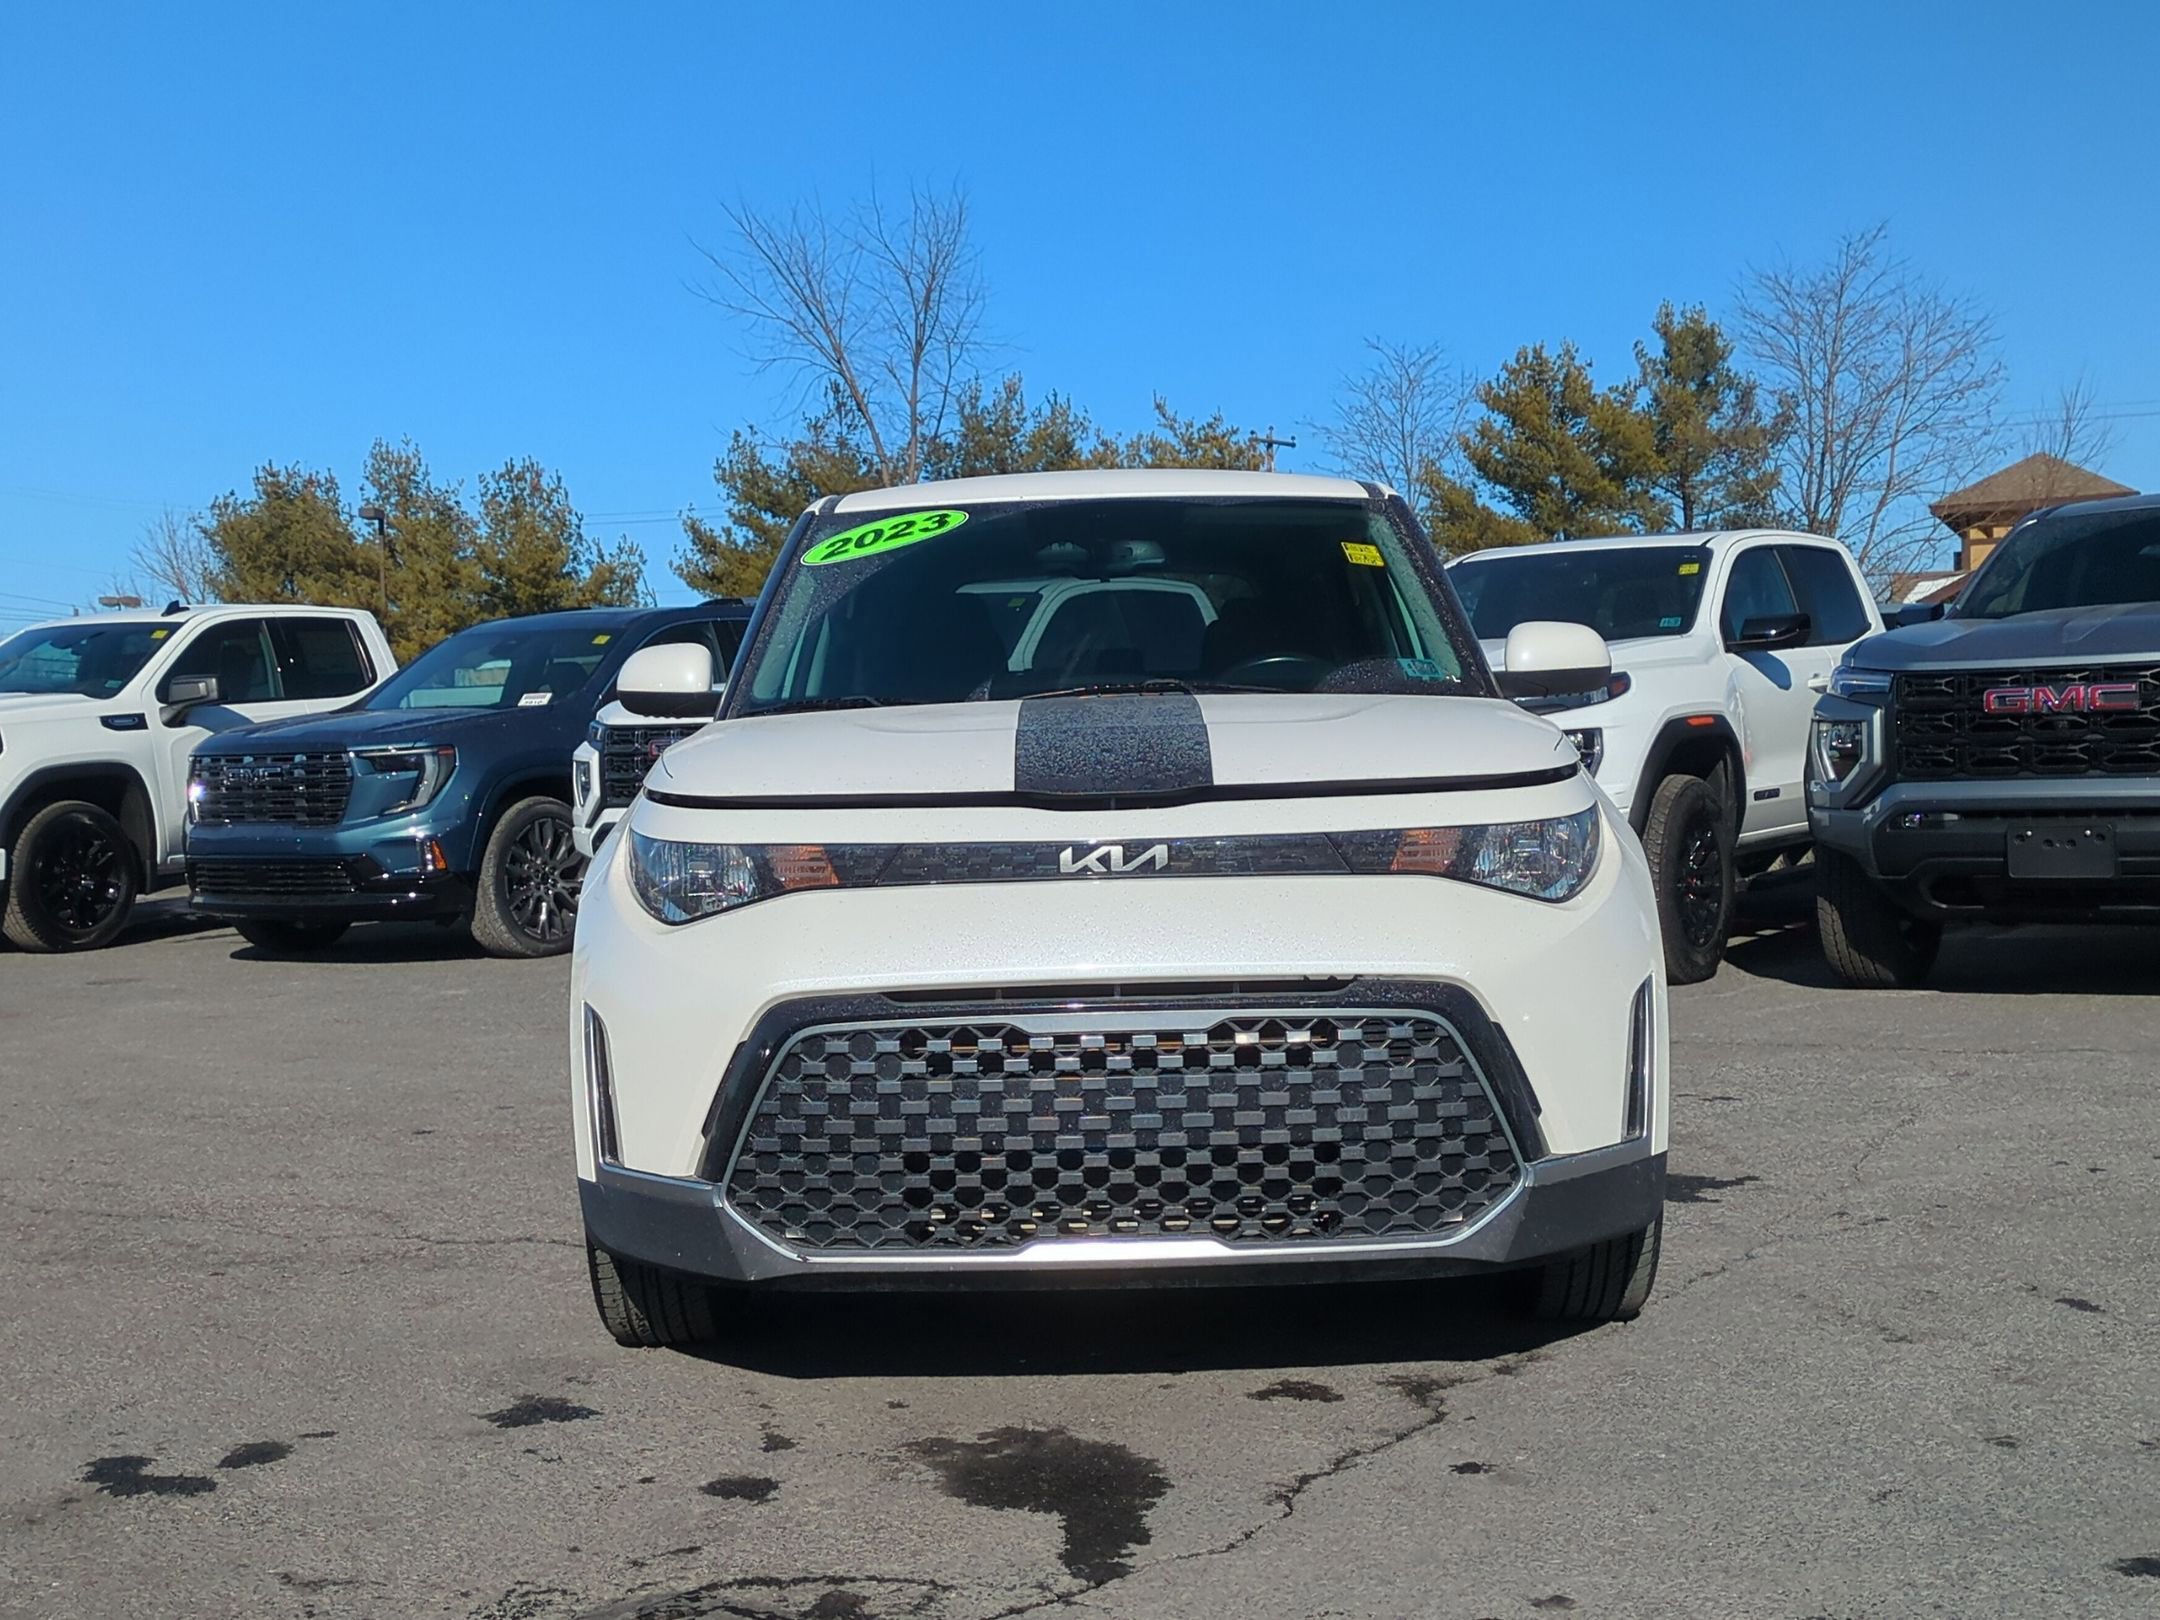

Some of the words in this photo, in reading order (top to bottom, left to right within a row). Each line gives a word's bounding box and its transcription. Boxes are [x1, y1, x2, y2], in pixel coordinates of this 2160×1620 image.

[820, 513, 951, 561] 2023
[1984, 683, 2138, 714] GMC
[1059, 844, 1168, 873] KIA
